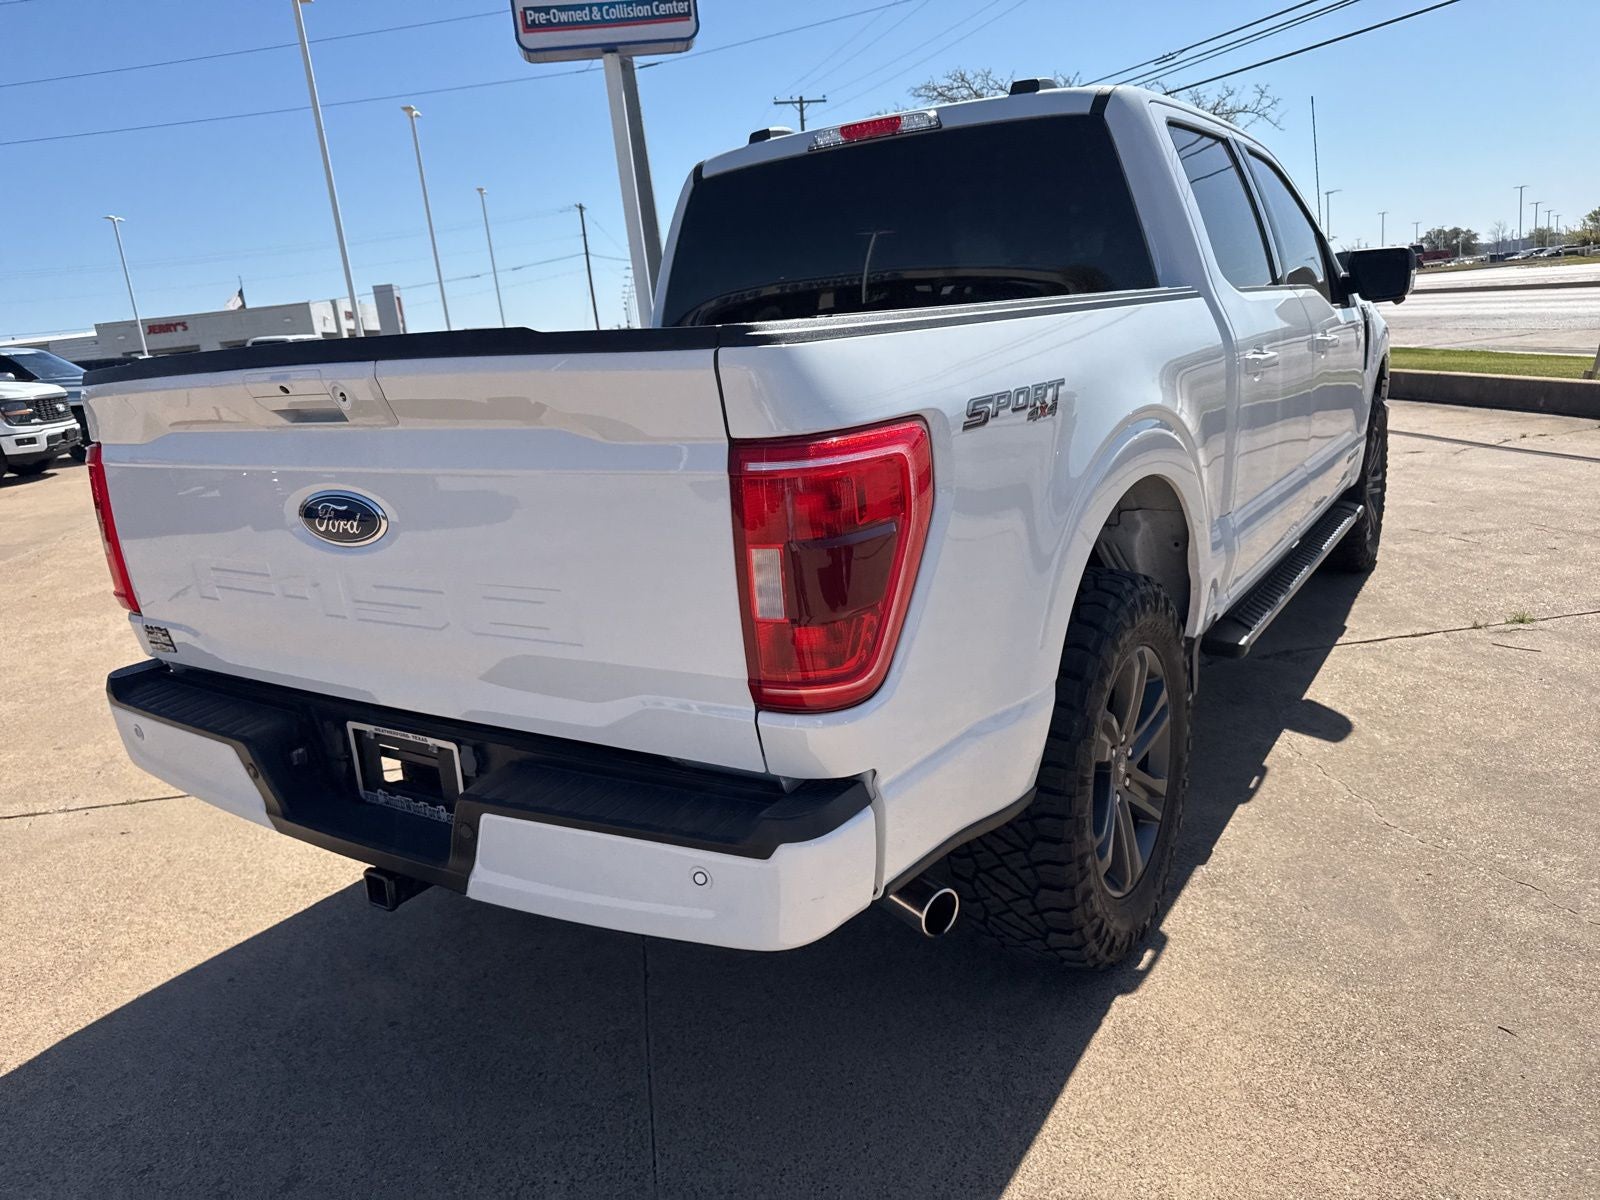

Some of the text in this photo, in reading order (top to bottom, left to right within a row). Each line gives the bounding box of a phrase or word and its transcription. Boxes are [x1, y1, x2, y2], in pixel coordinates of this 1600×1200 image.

[526, 1, 689, 25] Pre-Owned & Collision Center
[147, 321, 189, 335] JERRY'S
[962, 378, 1065, 432] SPORT
[315, 502, 362, 534] Ford
